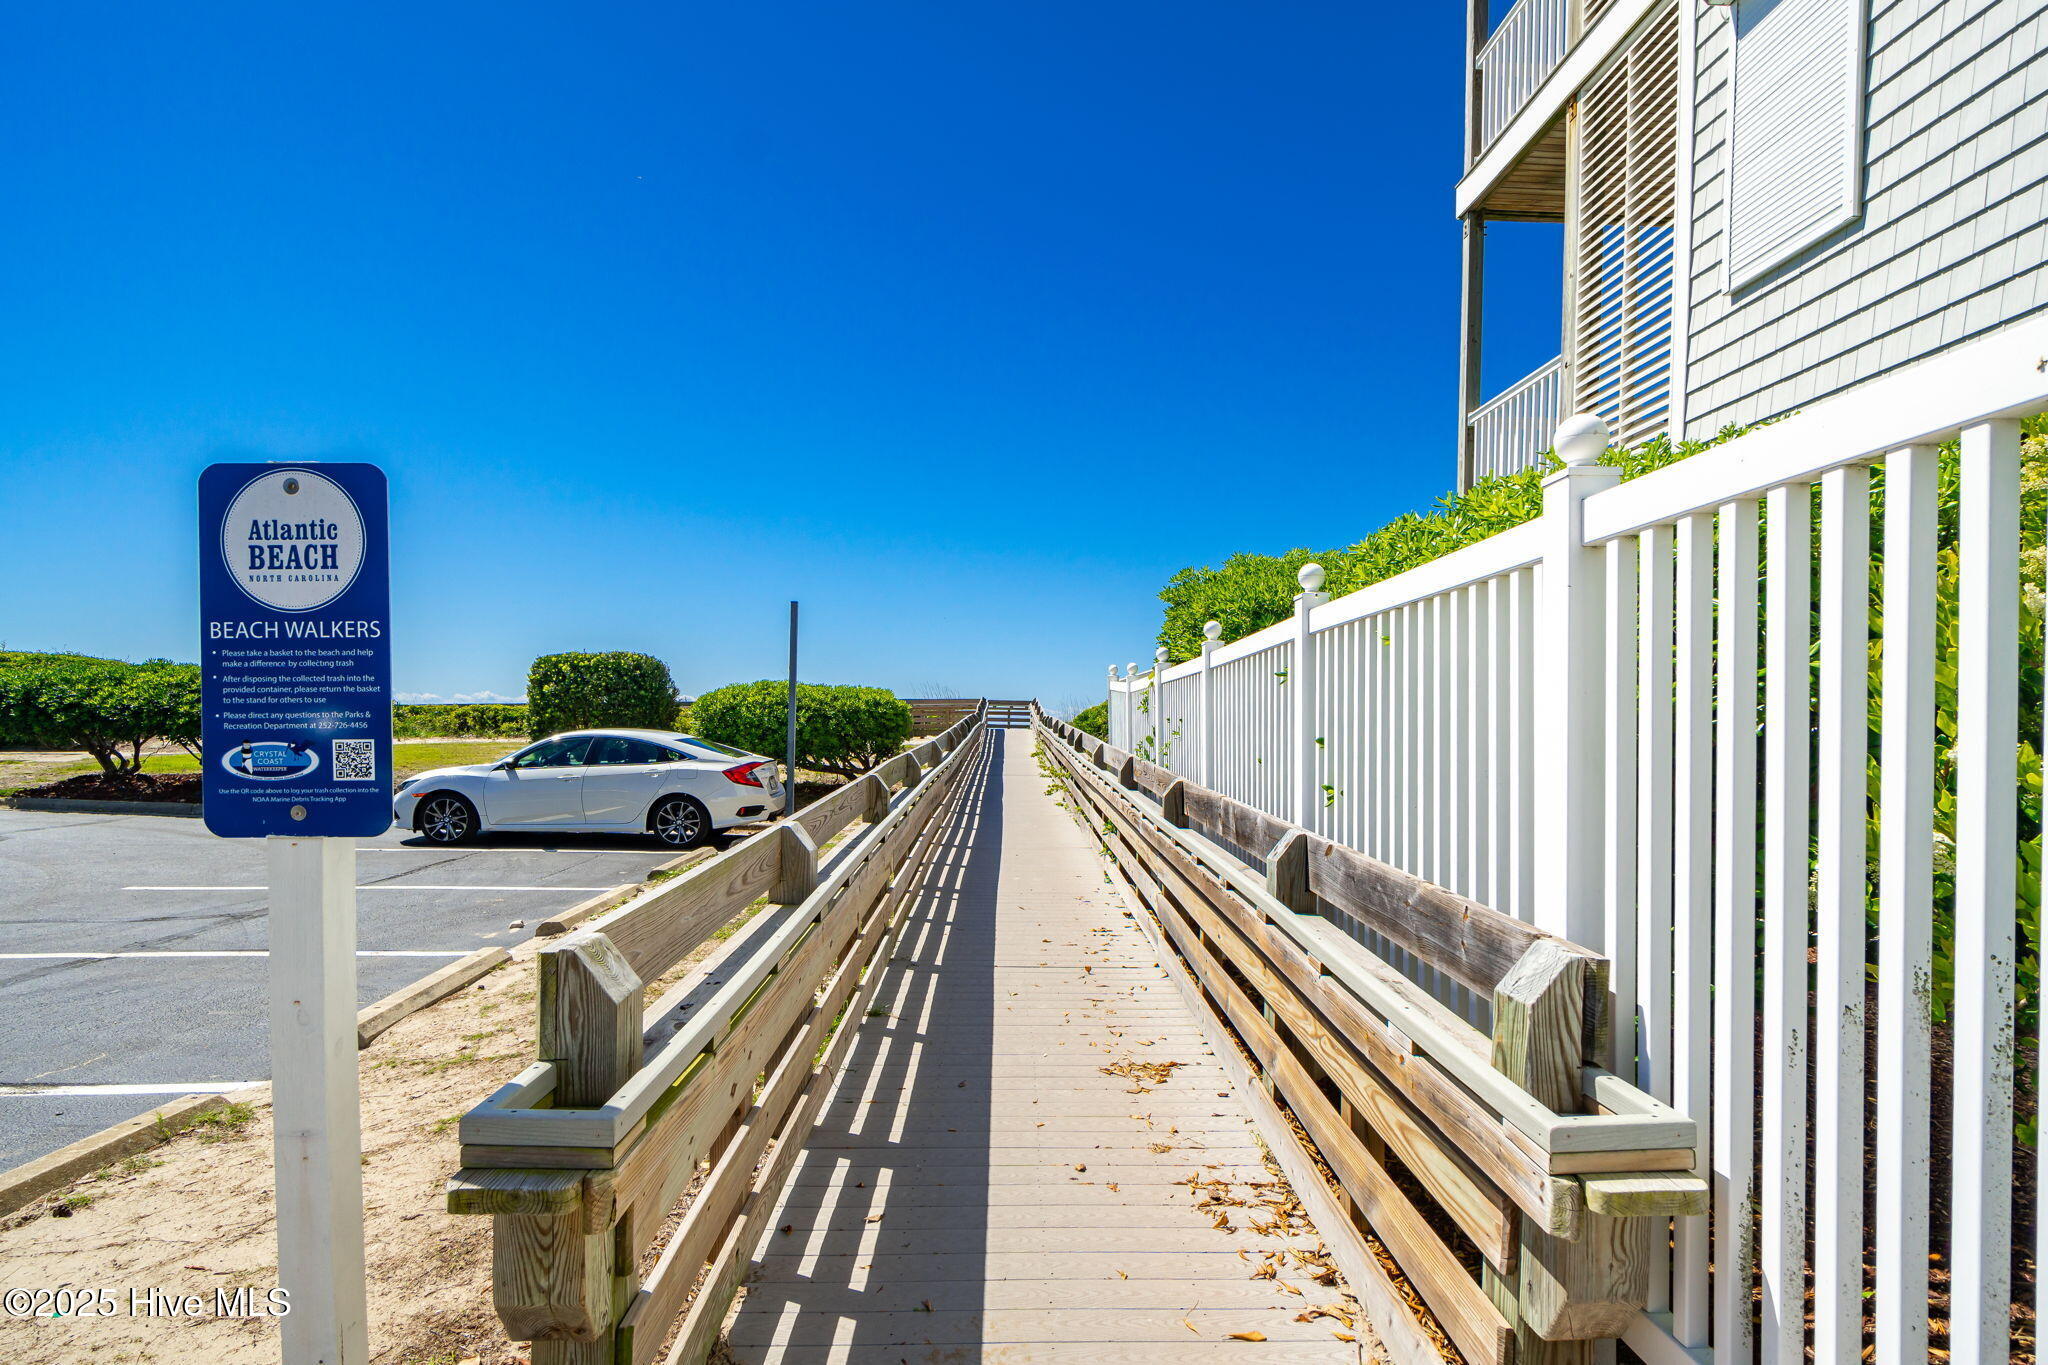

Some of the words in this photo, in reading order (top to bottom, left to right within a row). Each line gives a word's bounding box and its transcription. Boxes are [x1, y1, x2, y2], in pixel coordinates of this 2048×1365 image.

[248, 518, 338, 540] Atlantic
[248, 544, 339, 570] BEACH
[210, 622, 278, 638] BEACH
[284, 620, 381, 638] WALKERS
[357, 649, 374, 658] help
[288, 660, 298, 668] by
[298, 660, 334, 668] collecting
[242, 675, 278, 684] disposing
[294, 686, 318, 694] please
[264, 722, 308, 730] Department
